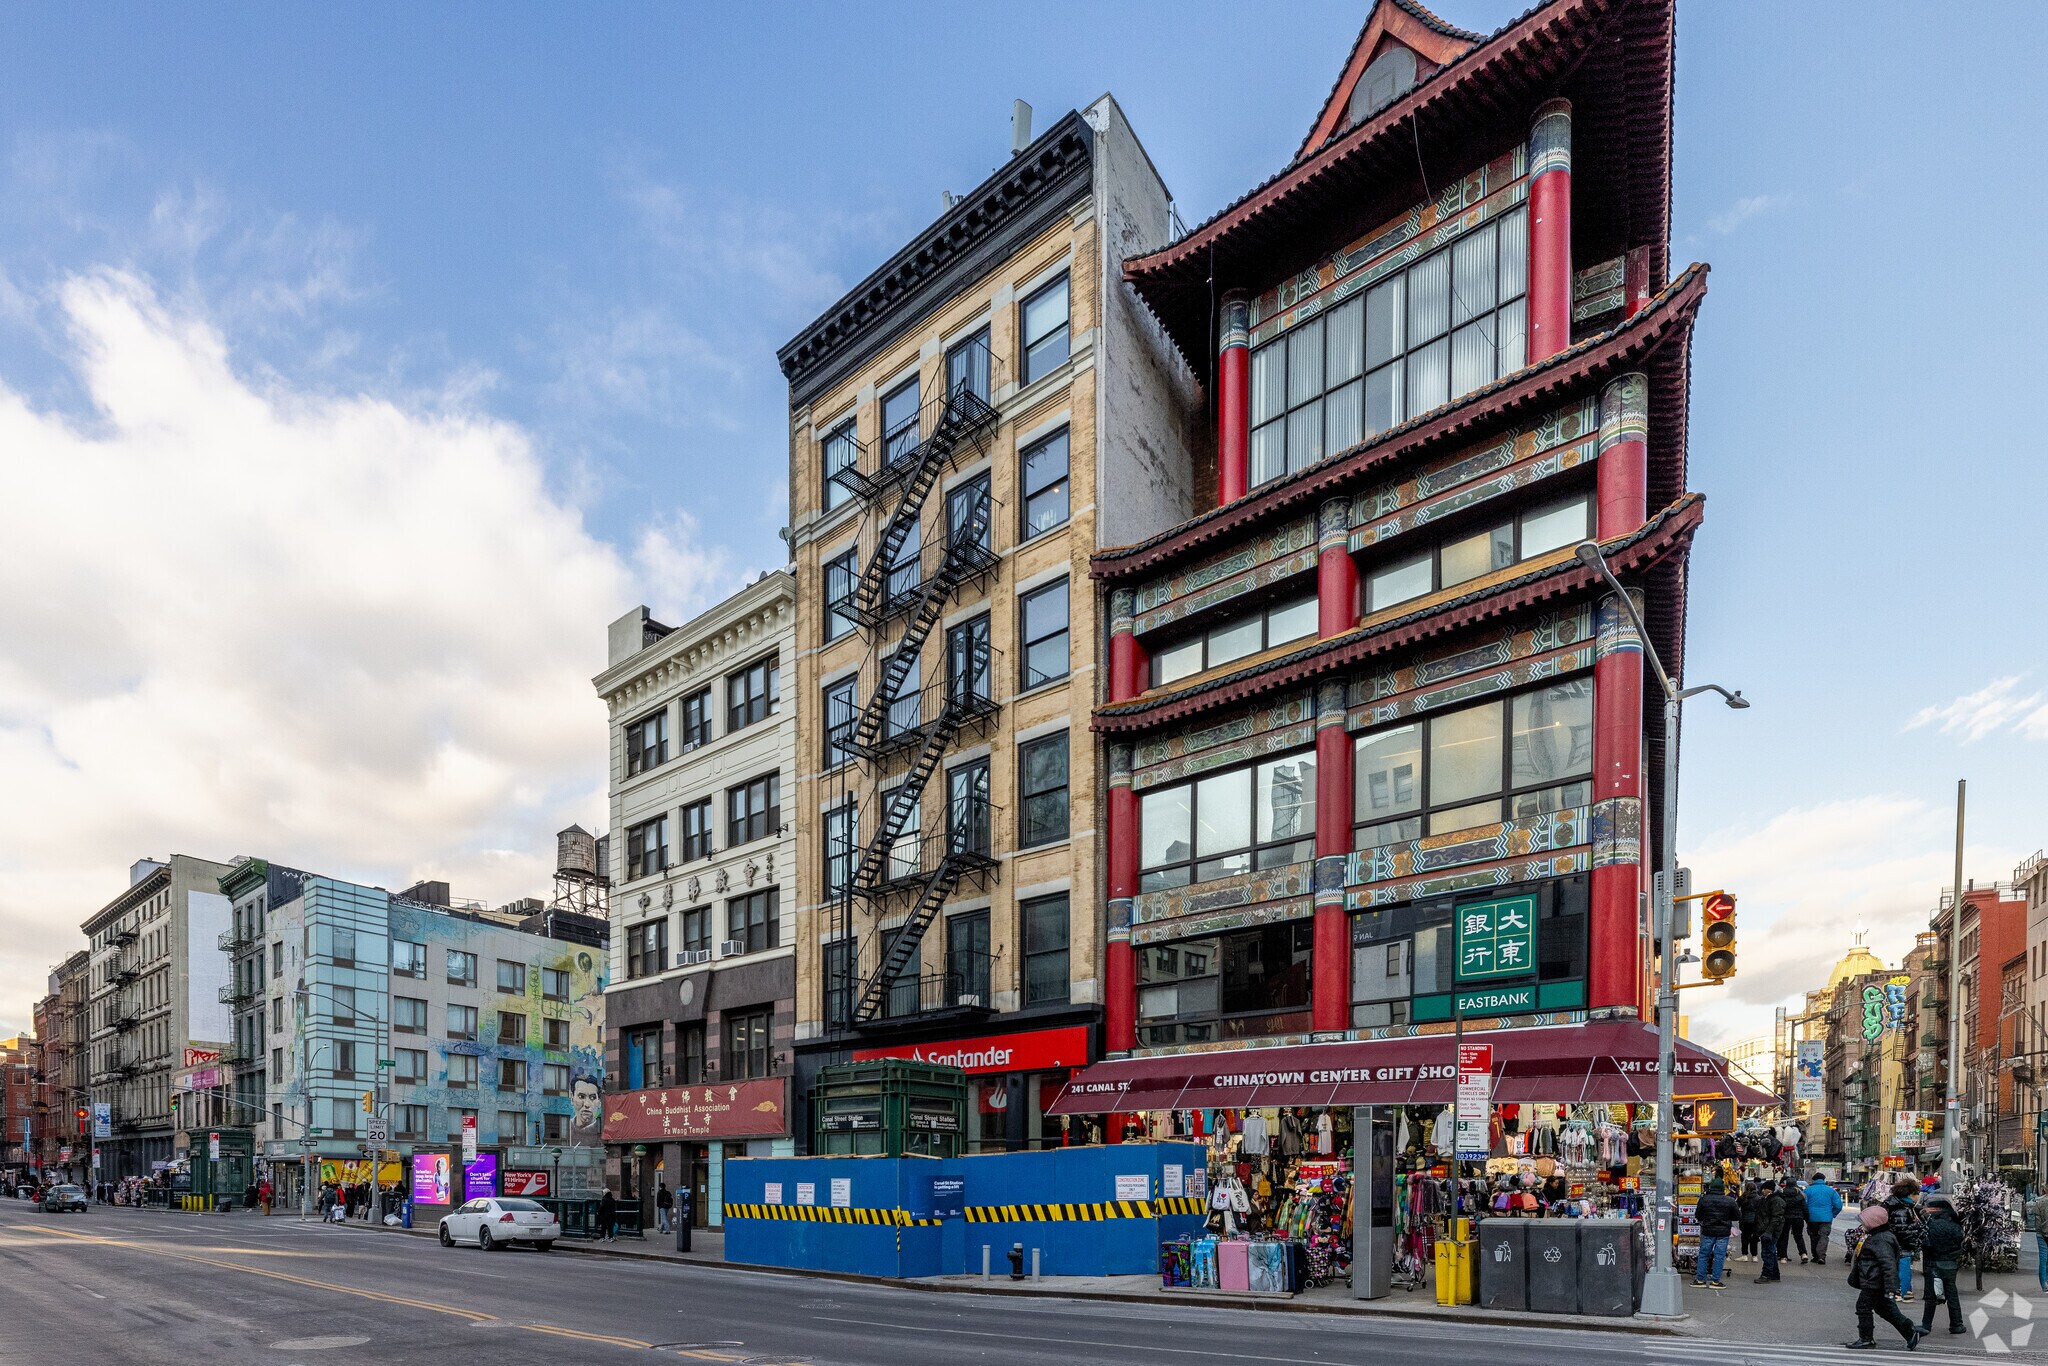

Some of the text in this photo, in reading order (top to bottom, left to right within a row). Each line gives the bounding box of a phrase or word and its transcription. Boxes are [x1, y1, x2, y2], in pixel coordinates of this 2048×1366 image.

[1458, 992, 1530, 1010] EASTBANK
[928, 1046, 1013, 1069] Santander
[1620, 1061, 1713, 1073] 241 CAAL ST.
[1213, 1065, 1456, 1087] CHINATOWN CENTER GIFT SHO
[1460, 1076, 1467, 1084] 3
[1071, 1082, 1131, 1094] 241 CANAL ST.
[639, 1086, 738, 1107] 中華佛教會
[646, 1104, 731, 1116] China Buddhist Association
[663, 1113, 712, 1127] 法王寺
[672, 1127, 687, 1136] Wang
[689, 1126, 710, 1135] Temple
[1460, 1122, 1466, 1131] 5
[369, 1130, 386, 1140] 20
